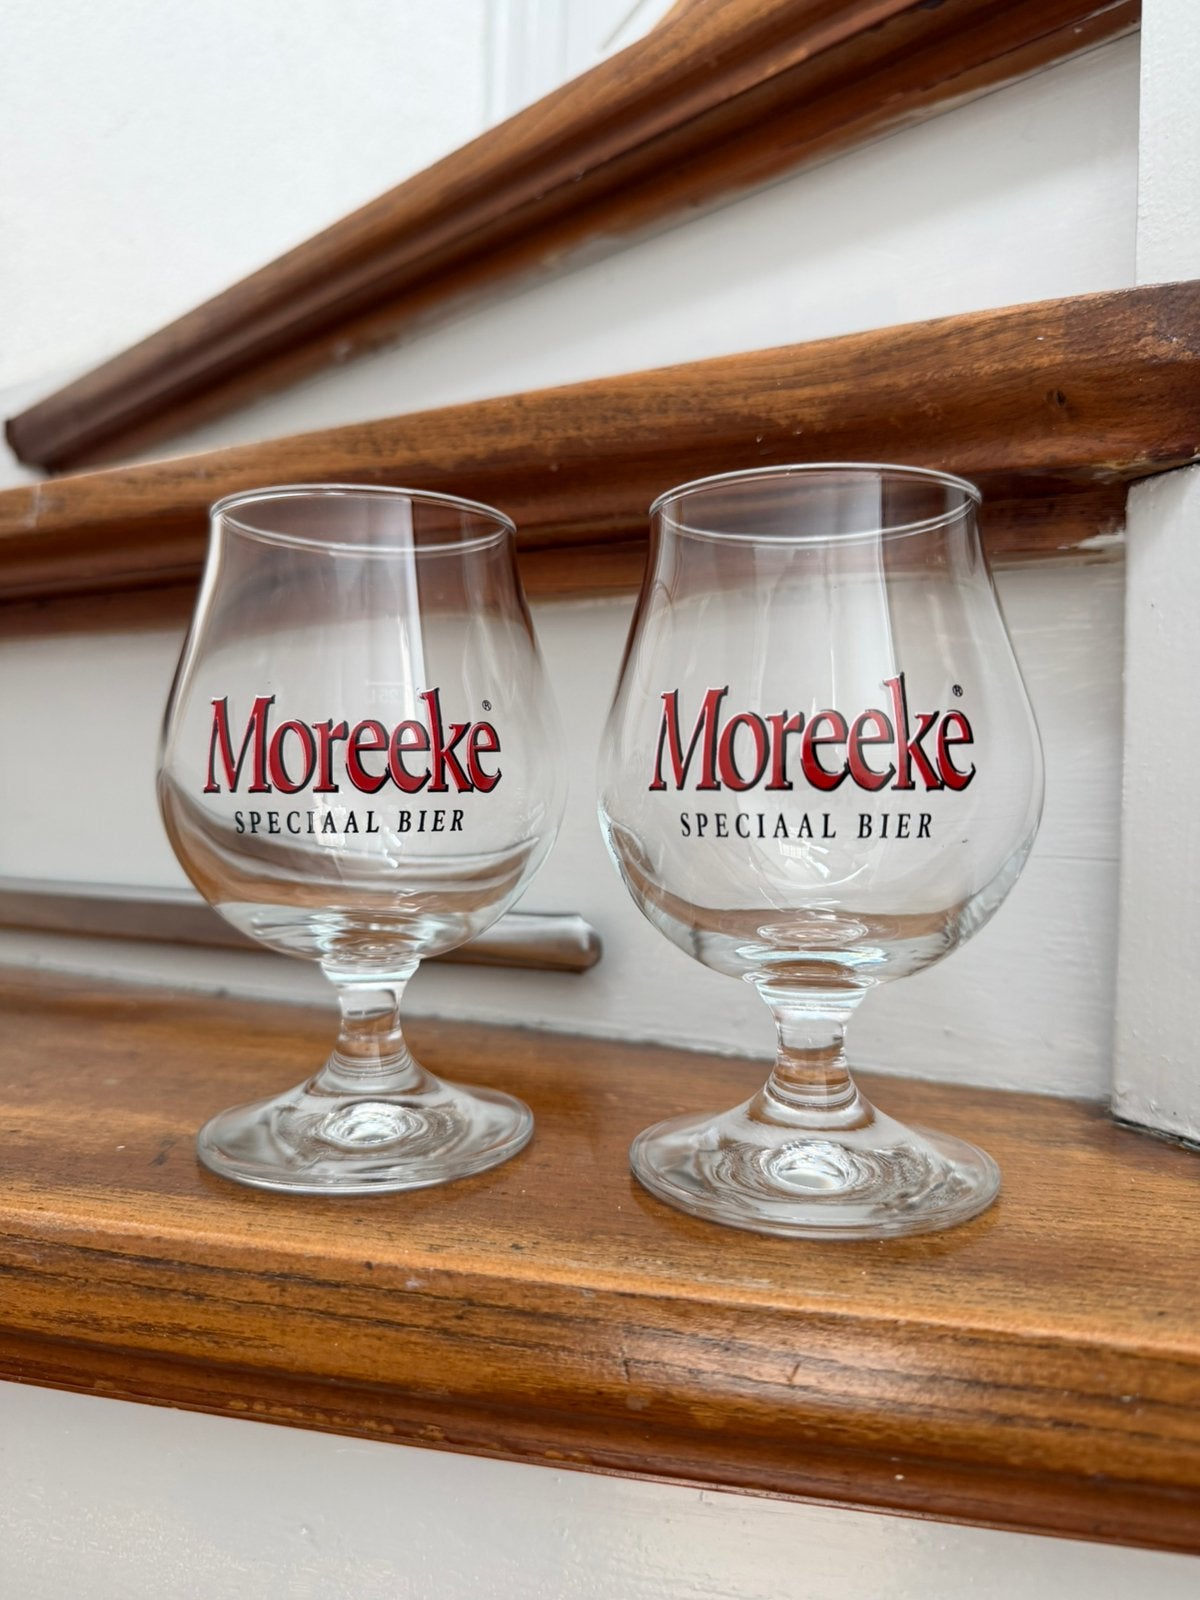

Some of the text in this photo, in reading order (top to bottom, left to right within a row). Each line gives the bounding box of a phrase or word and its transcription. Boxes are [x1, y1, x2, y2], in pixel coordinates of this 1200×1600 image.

[203, 687, 502, 794] Moreeke
[648, 671, 976, 792] Moreeke
[234, 809, 465, 834] SPECIAAL BIER
[680, 812, 933, 839] SPECIAAL BIER
